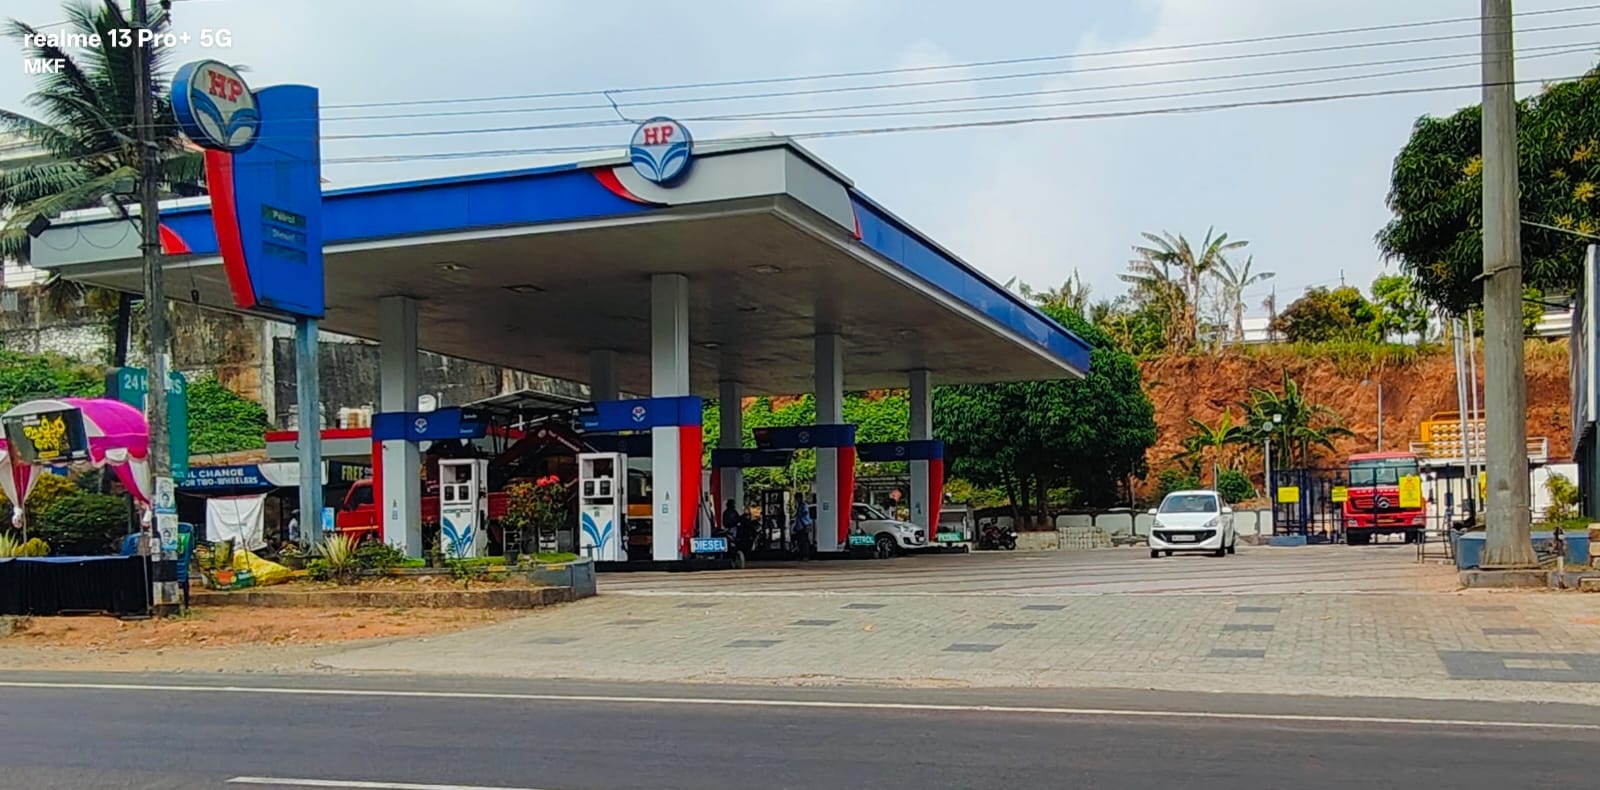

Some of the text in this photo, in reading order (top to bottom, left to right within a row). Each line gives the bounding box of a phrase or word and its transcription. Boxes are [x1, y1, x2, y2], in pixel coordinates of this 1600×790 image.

[208, 69, 244, 103] HP
[643, 125, 674, 146] HP
[124, 373, 139, 390] 24
[199, 468, 244, 477] CHANGE
[341, 465, 364, 480] FREE
[693, 539, 725, 550] DIESEL
